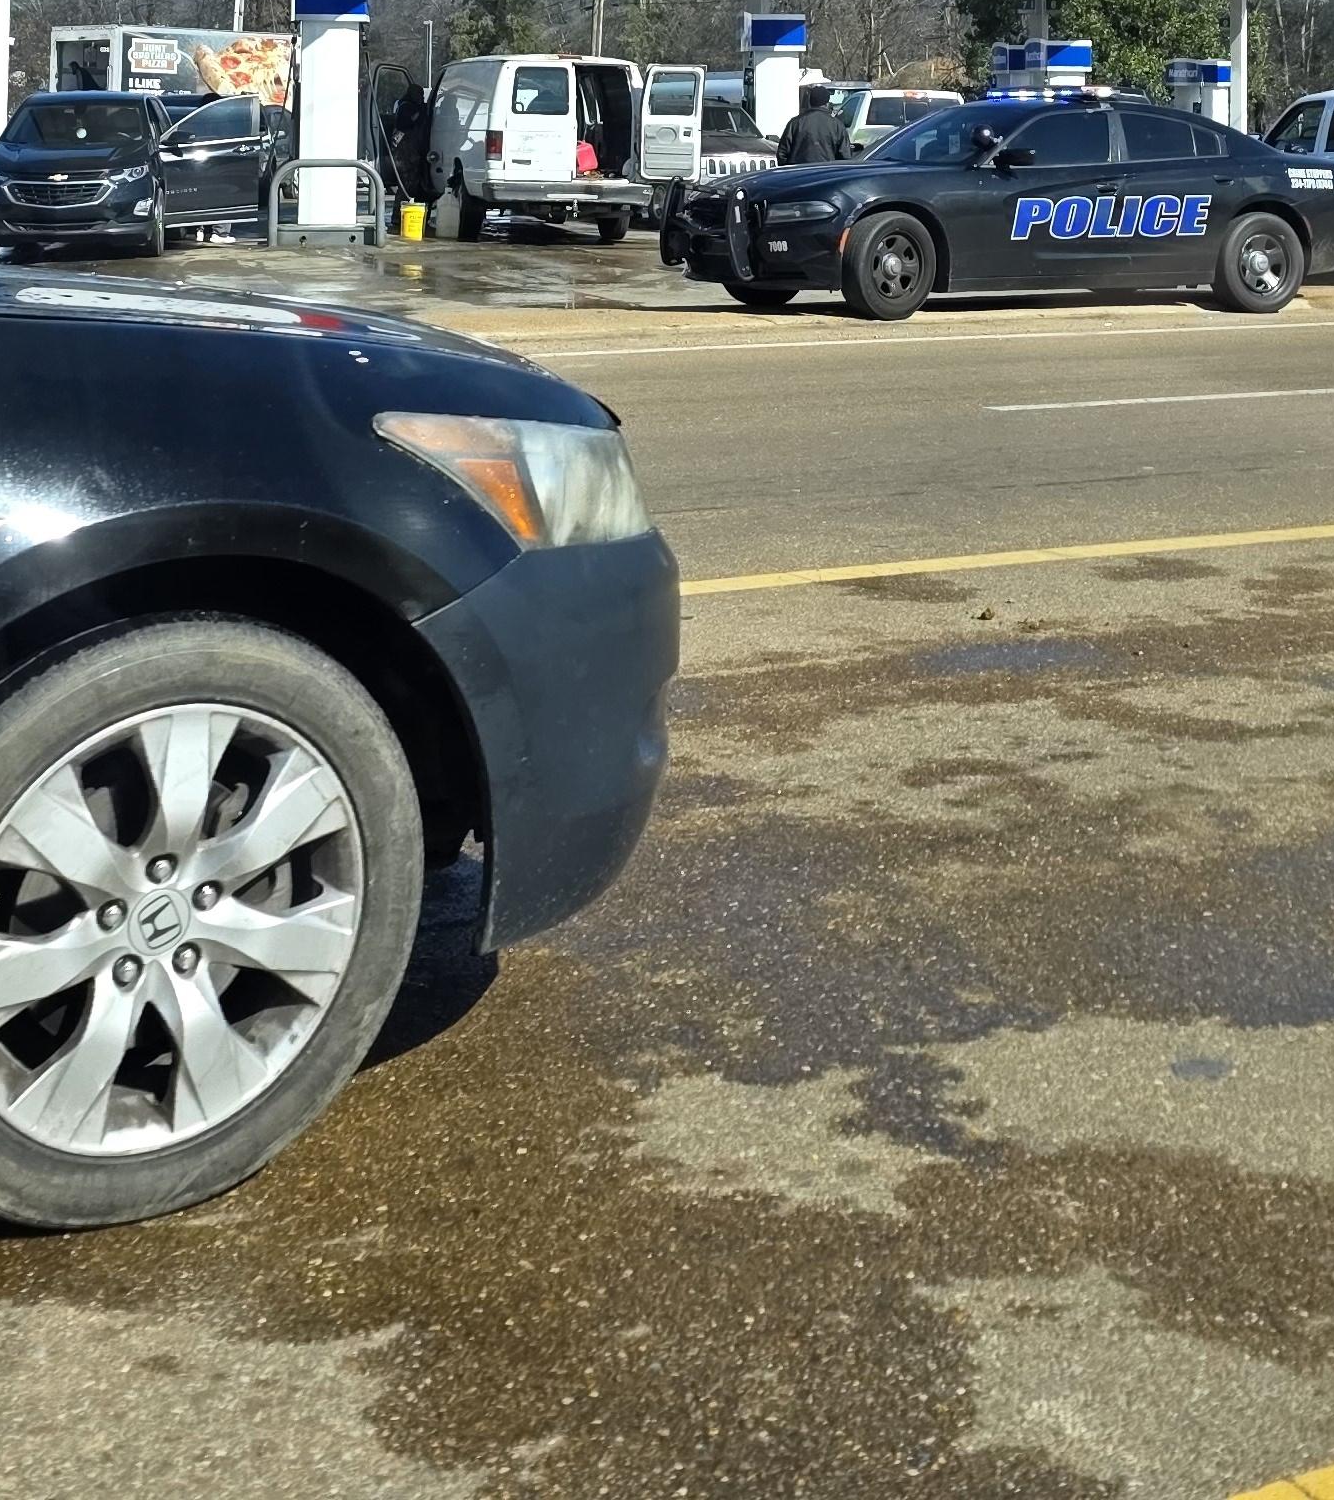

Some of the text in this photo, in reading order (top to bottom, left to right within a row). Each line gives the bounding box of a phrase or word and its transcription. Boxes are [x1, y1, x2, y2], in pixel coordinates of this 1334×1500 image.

[142, 44, 167, 52] HUNT
[142, 59, 167, 68] PIZZA
[135, 78, 162, 89] LIKE
[1011, 195, 1212, 240] POLICE
